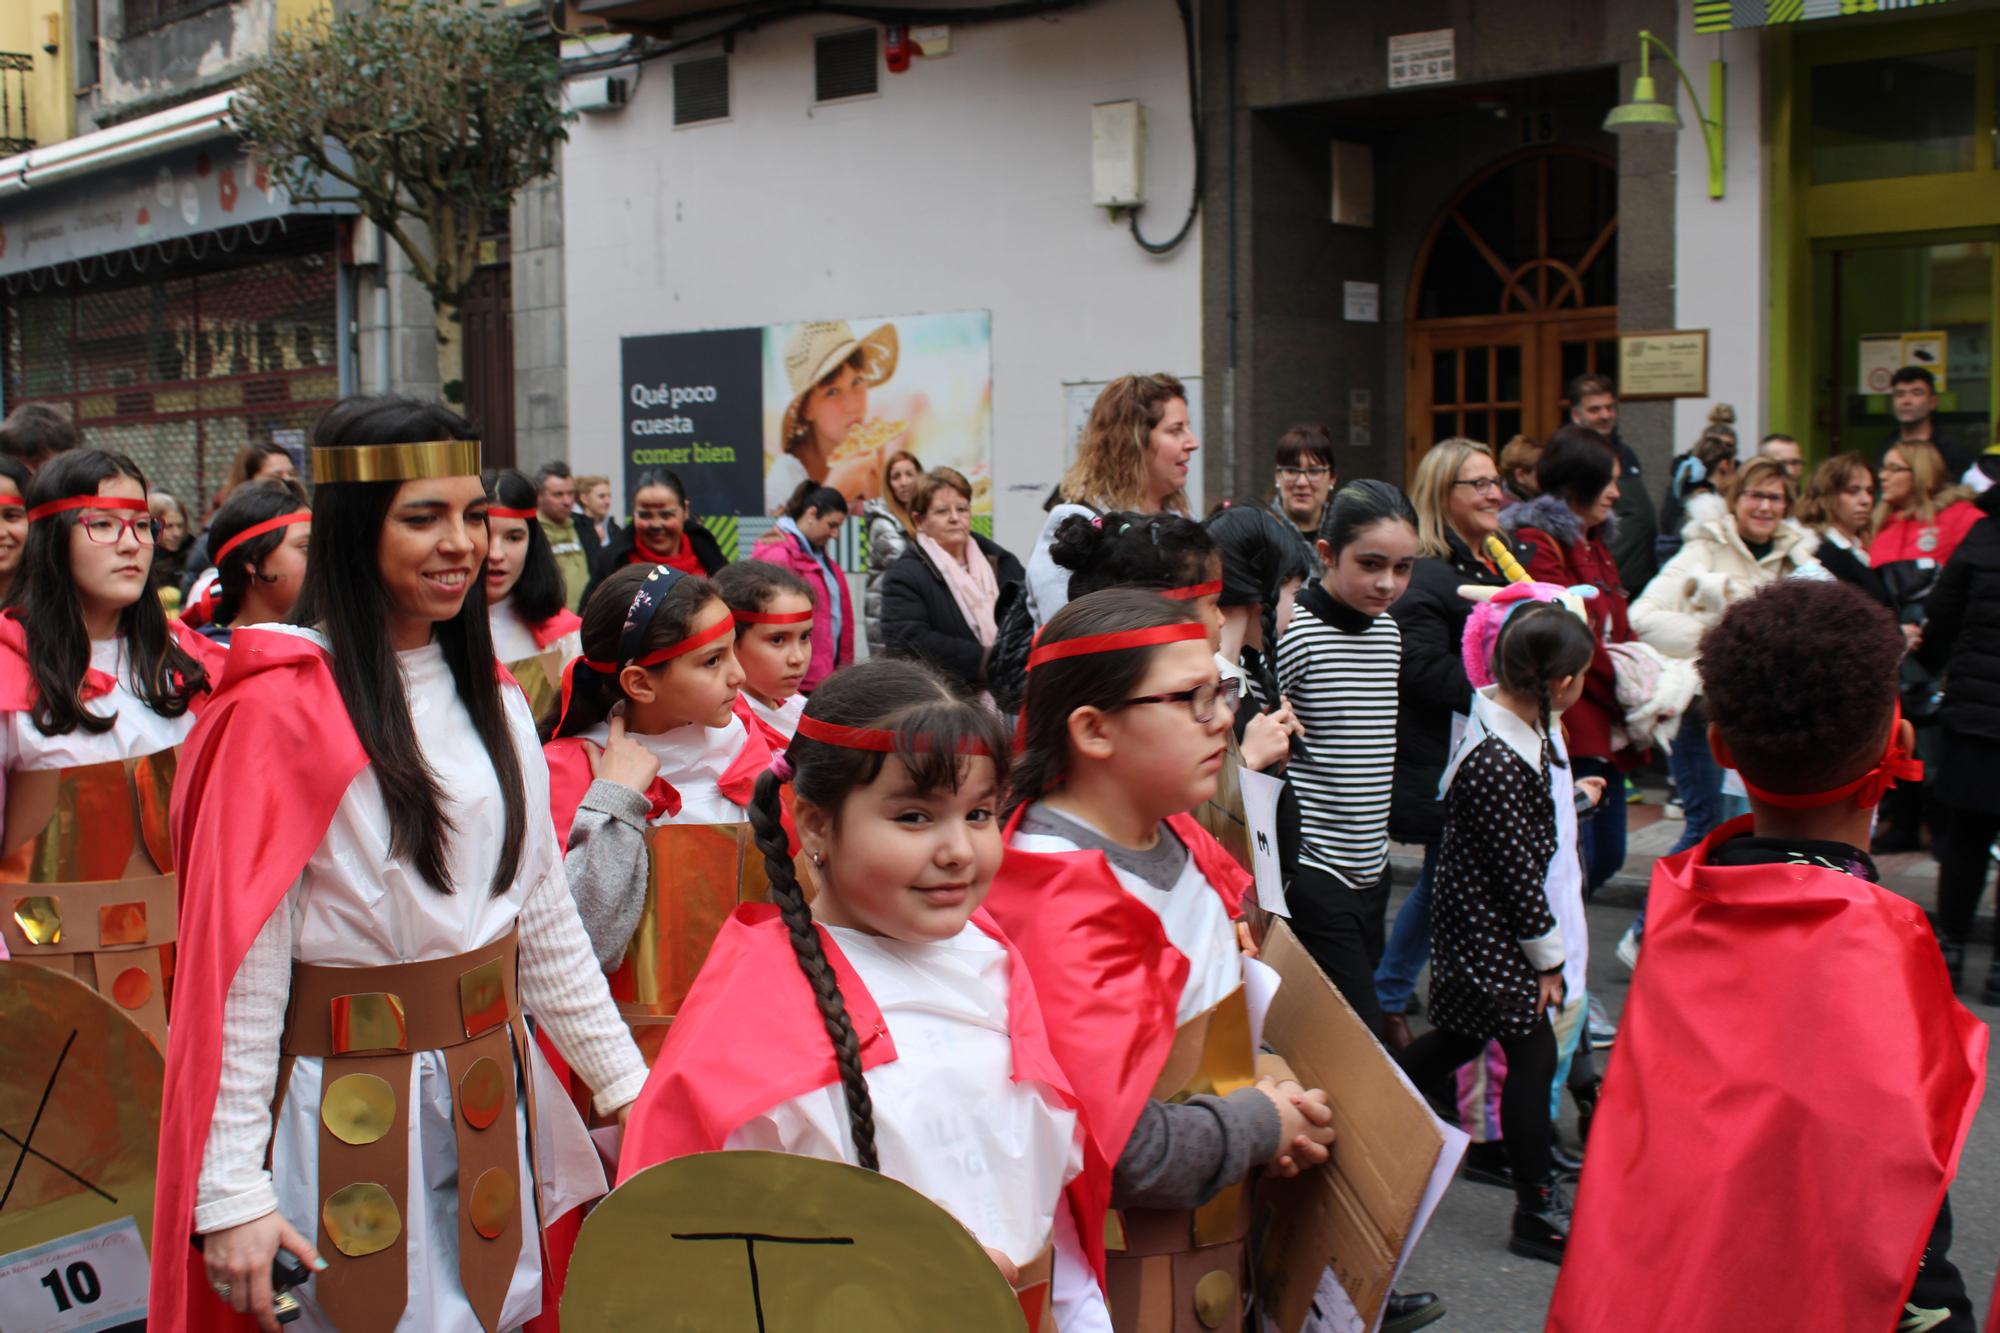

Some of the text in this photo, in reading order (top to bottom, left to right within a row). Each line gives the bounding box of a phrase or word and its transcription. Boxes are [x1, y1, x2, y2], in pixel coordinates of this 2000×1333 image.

[631, 384, 717, 409] Qué poco
[631, 415, 694, 435] cuesta
[632, 442, 736, 464] comer bien
[40, 1261, 101, 1312] 10
